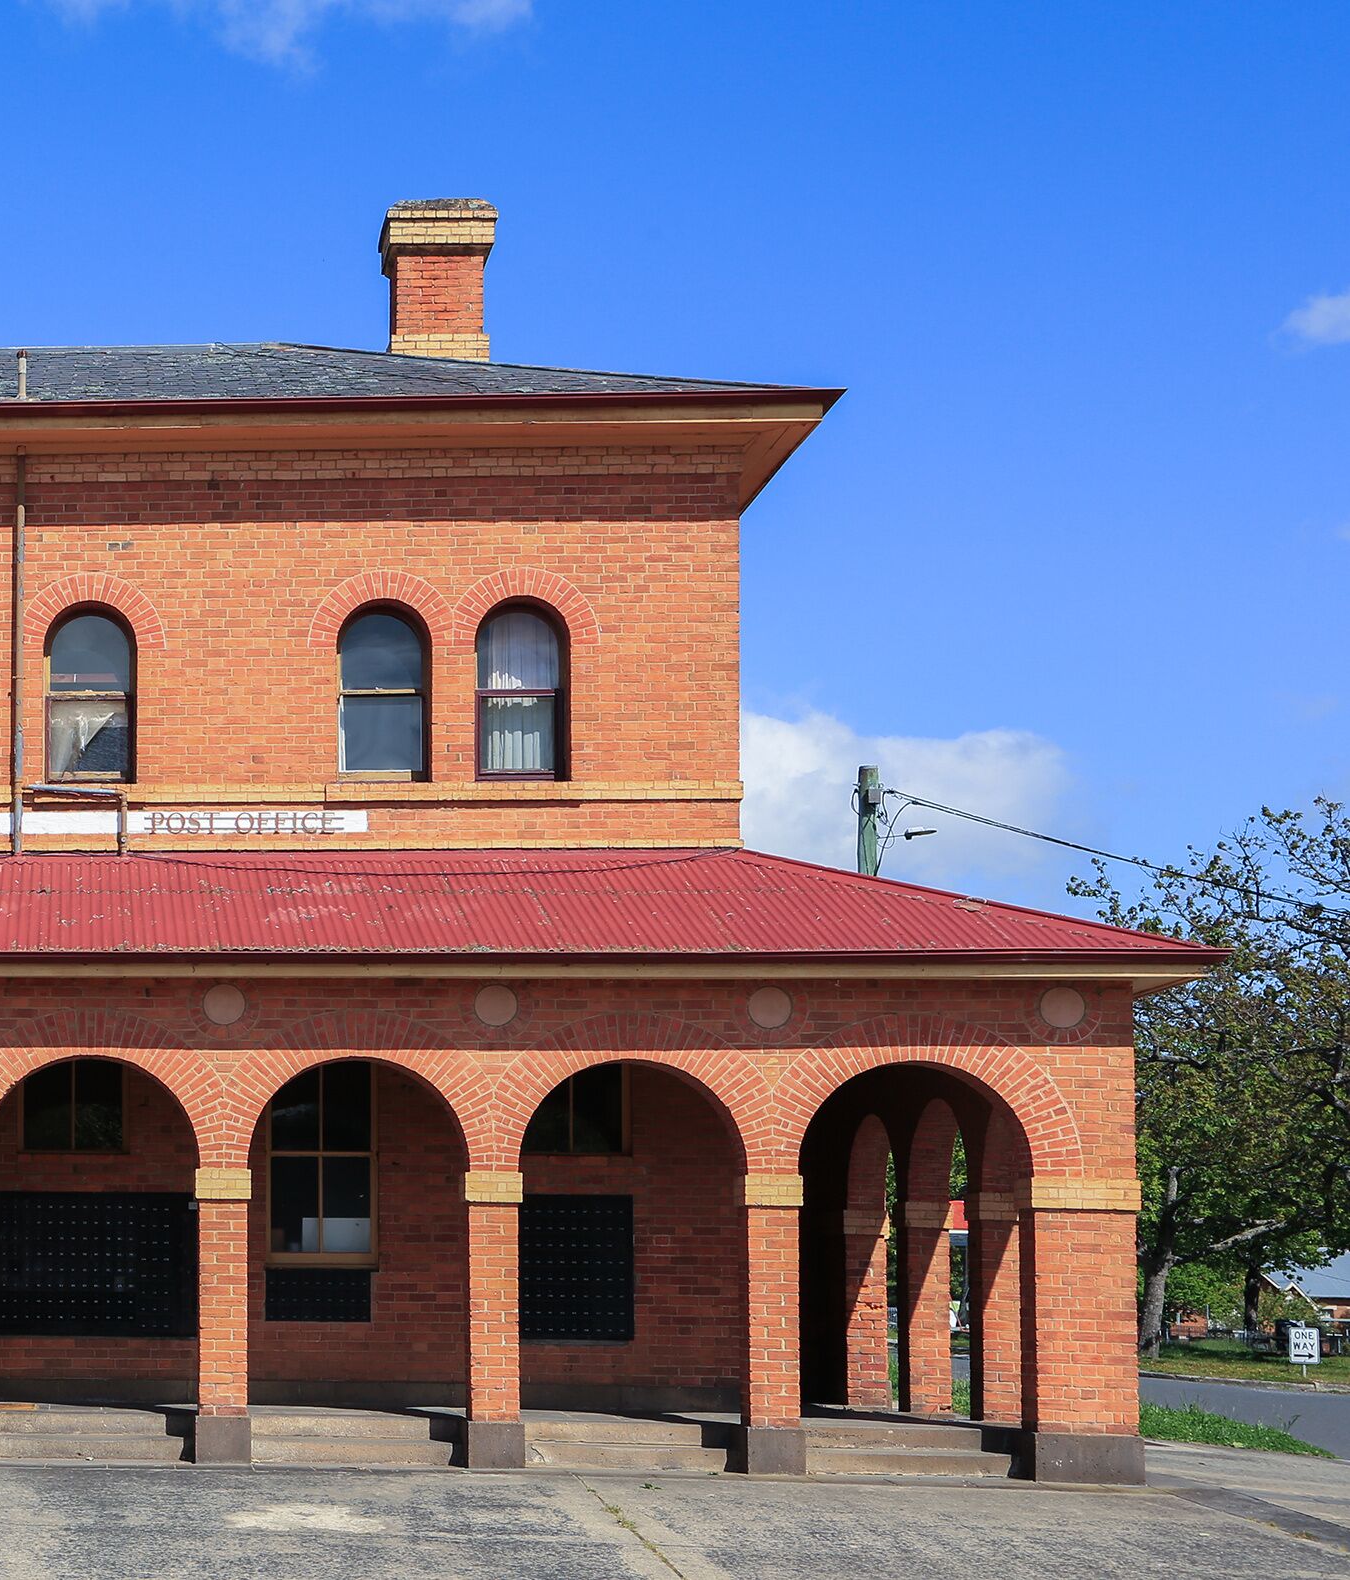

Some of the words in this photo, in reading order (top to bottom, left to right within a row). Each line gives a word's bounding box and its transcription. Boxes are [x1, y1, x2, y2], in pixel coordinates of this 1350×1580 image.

[149, 811, 221, 835] POST
[234, 811, 336, 835] OFFICE
[1294, 1331, 1314, 1340] ONE
[1293, 1342, 1315, 1350] WAY
